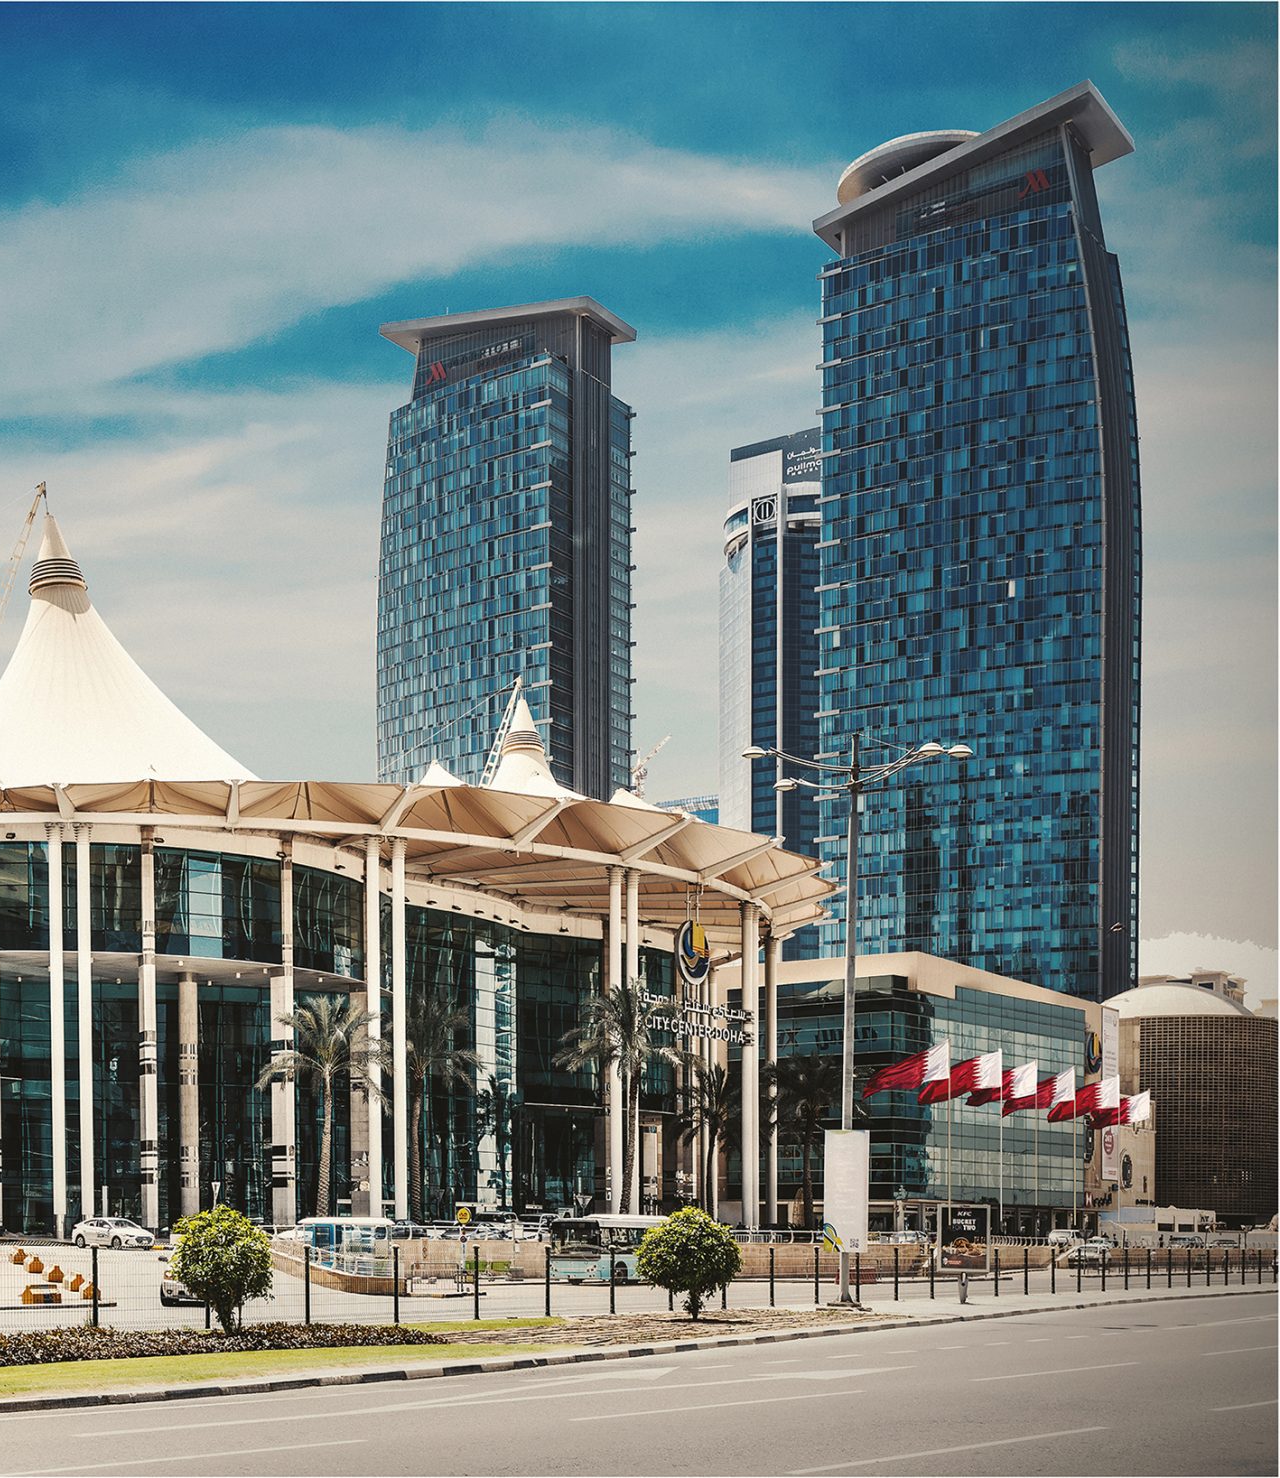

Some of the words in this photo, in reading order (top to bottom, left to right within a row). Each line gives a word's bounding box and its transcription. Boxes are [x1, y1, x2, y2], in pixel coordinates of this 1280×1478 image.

[787, 460, 822, 475] pullma
[645, 1014, 670, 1030] CITY
[670, 1019, 713, 1039] CENTER
[714, 1028, 745, 1044] DOHA
